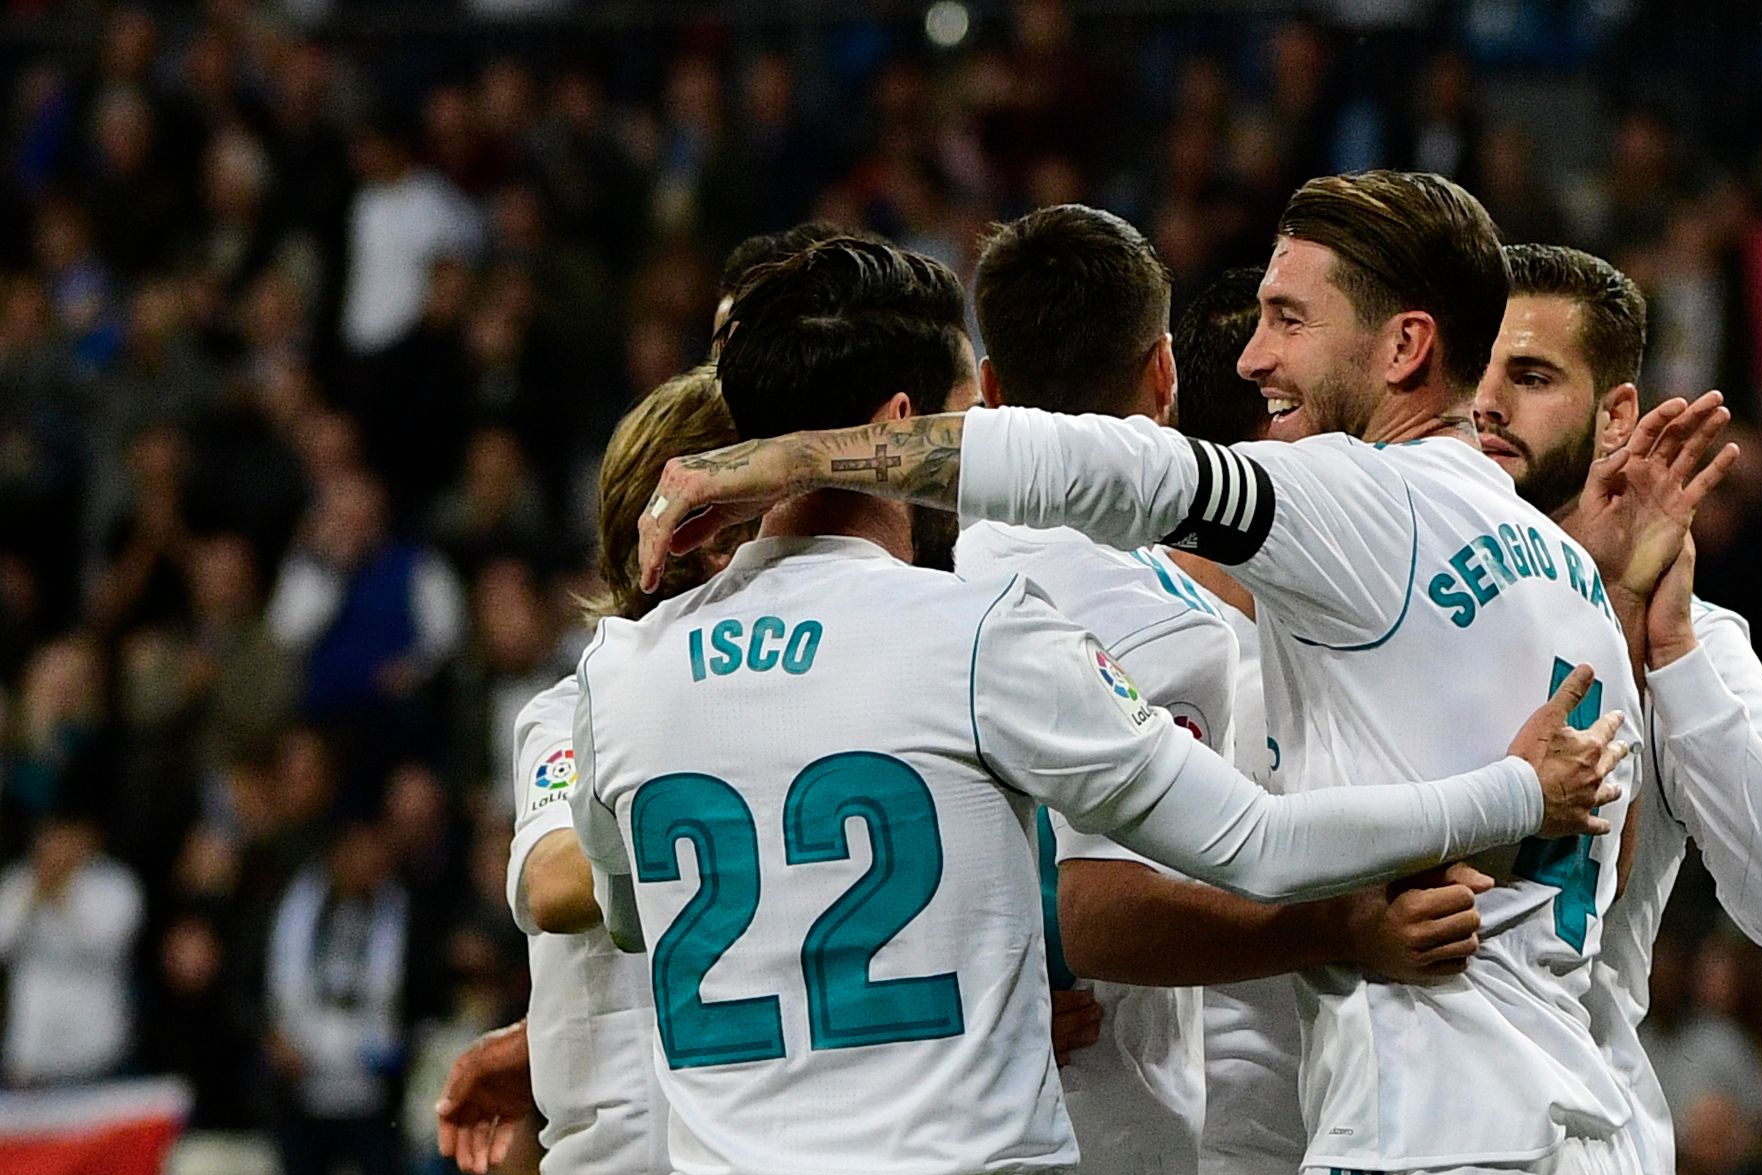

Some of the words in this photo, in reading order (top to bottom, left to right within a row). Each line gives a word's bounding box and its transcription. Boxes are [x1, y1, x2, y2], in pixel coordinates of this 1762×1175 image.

[1428, 523, 1557, 628] SERGIO
[1560, 540, 1622, 634] RA
[688, 615, 823, 683] ISCO
[630, 750, 965, 1071] 22
